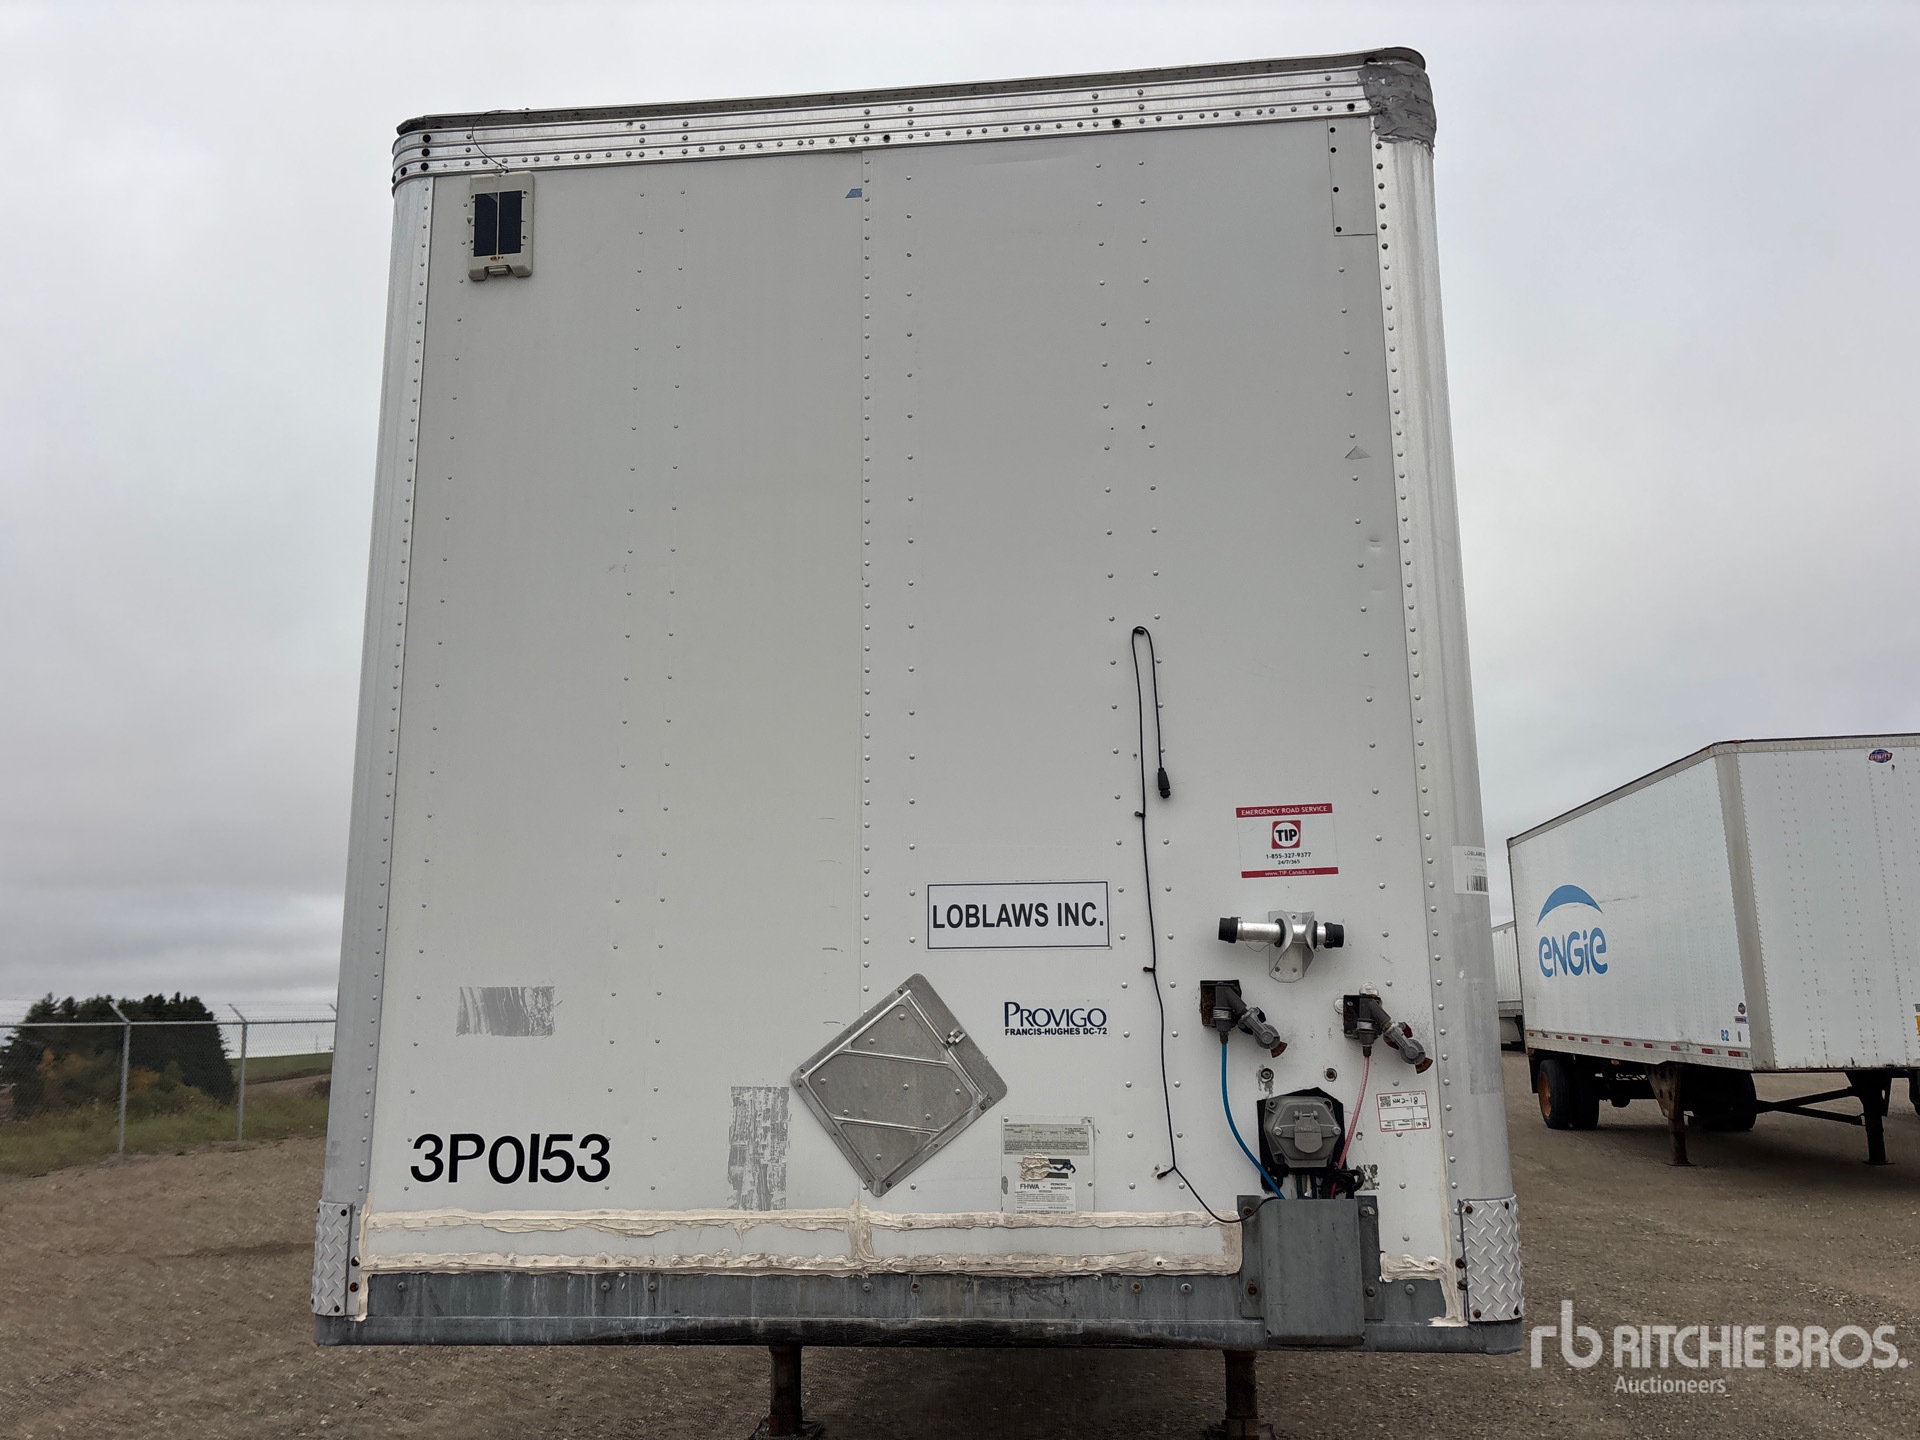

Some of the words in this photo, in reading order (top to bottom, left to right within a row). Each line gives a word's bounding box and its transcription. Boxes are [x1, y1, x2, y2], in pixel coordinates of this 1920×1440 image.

[1241, 808, 1280, 816] EMERGENCY
[1281, 806, 1300, 814] ROAD
[1301, 805, 1328, 813] SERVICE
[1275, 829, 1298, 842] TIP
[932, 902, 1049, 929] LOBLAWS
[1057, 902, 1104, 927] INC.
[1004, 1001, 1107, 1028] PROVIGO
[1004, 1027, 1081, 1036] FRANCIS-HUGHES
[1082, 1027, 1108, 1035] DC-72
